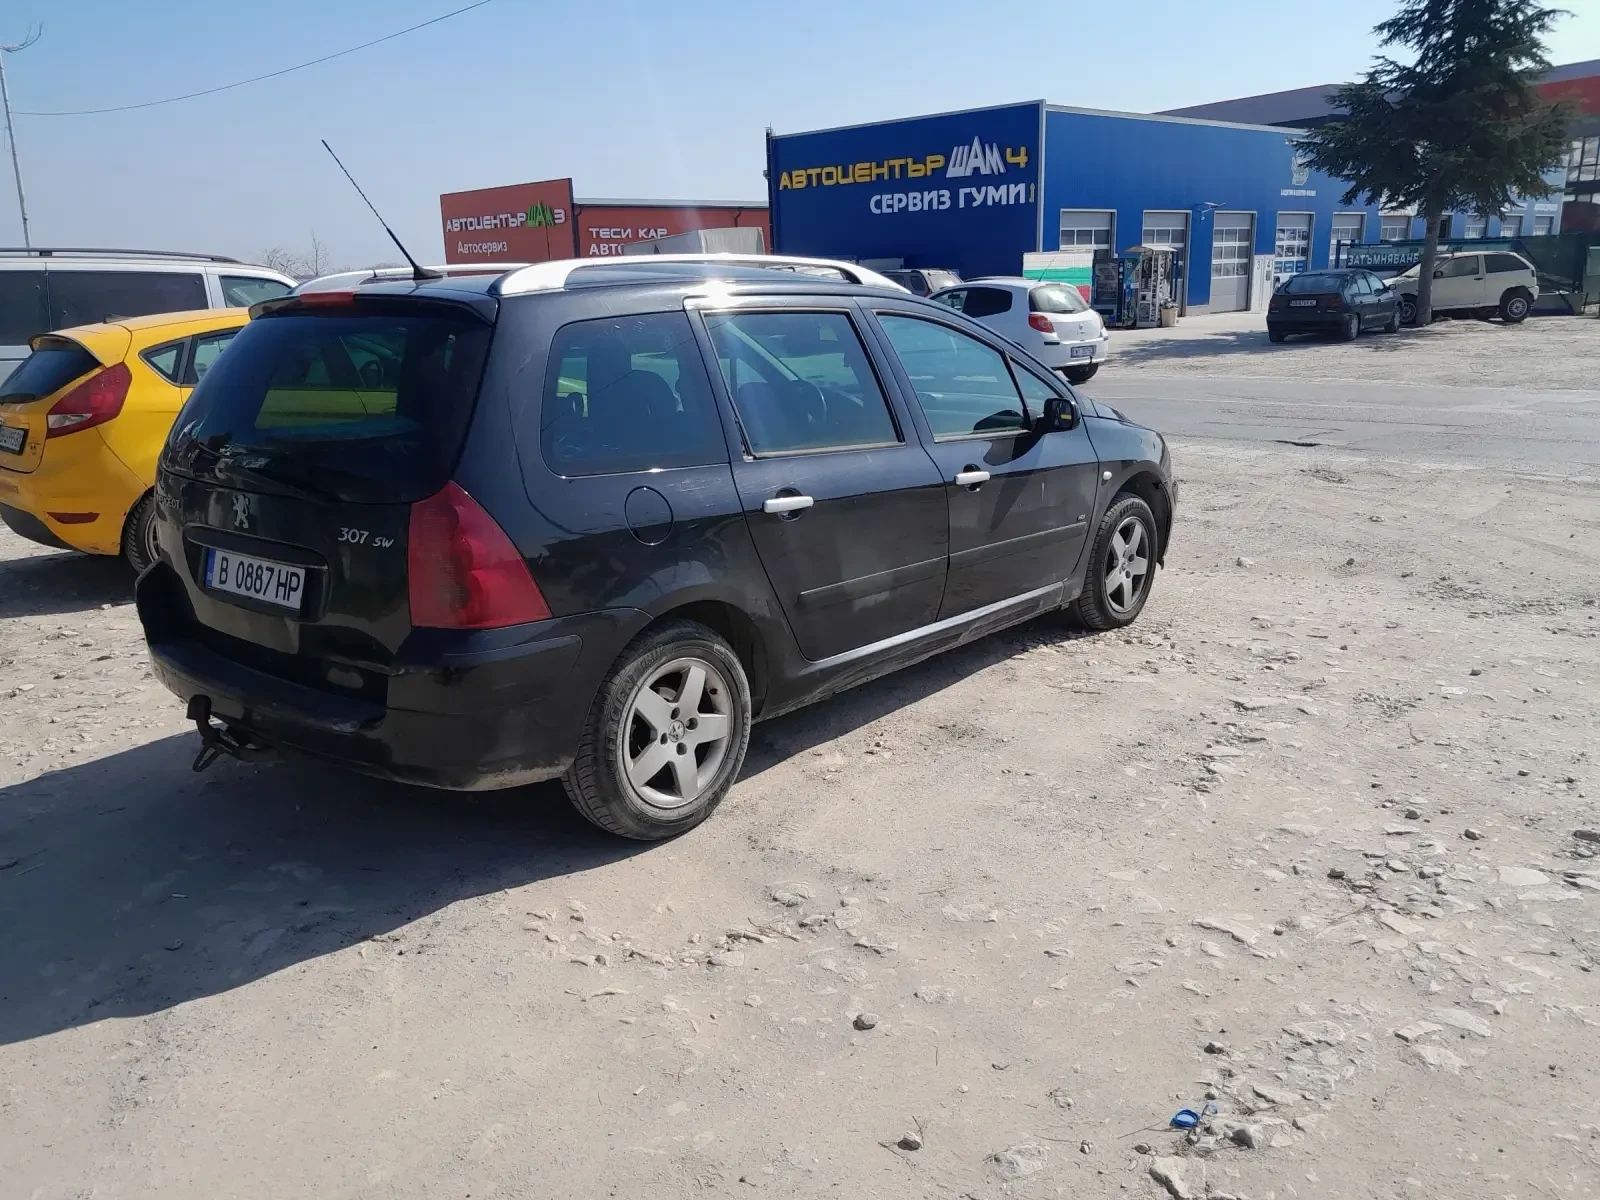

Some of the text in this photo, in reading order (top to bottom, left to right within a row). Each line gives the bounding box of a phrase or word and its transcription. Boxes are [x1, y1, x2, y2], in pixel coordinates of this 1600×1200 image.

[779, 155, 945, 190] АВТОЦЕНТЪР
[946, 135, 1006, 179] ШАМ
[869, 183, 1026, 214] СЕРВИЗ ГУМИ
[446, 213, 526, 233] АВТОЦЕНТЪР
[589, 227, 668, 239] ТЕСИ КАР
[457, 240, 508, 256] Автосервиз
[338, 527, 369, 543] 307
[219, 557, 301, 602] B 0887 HP
